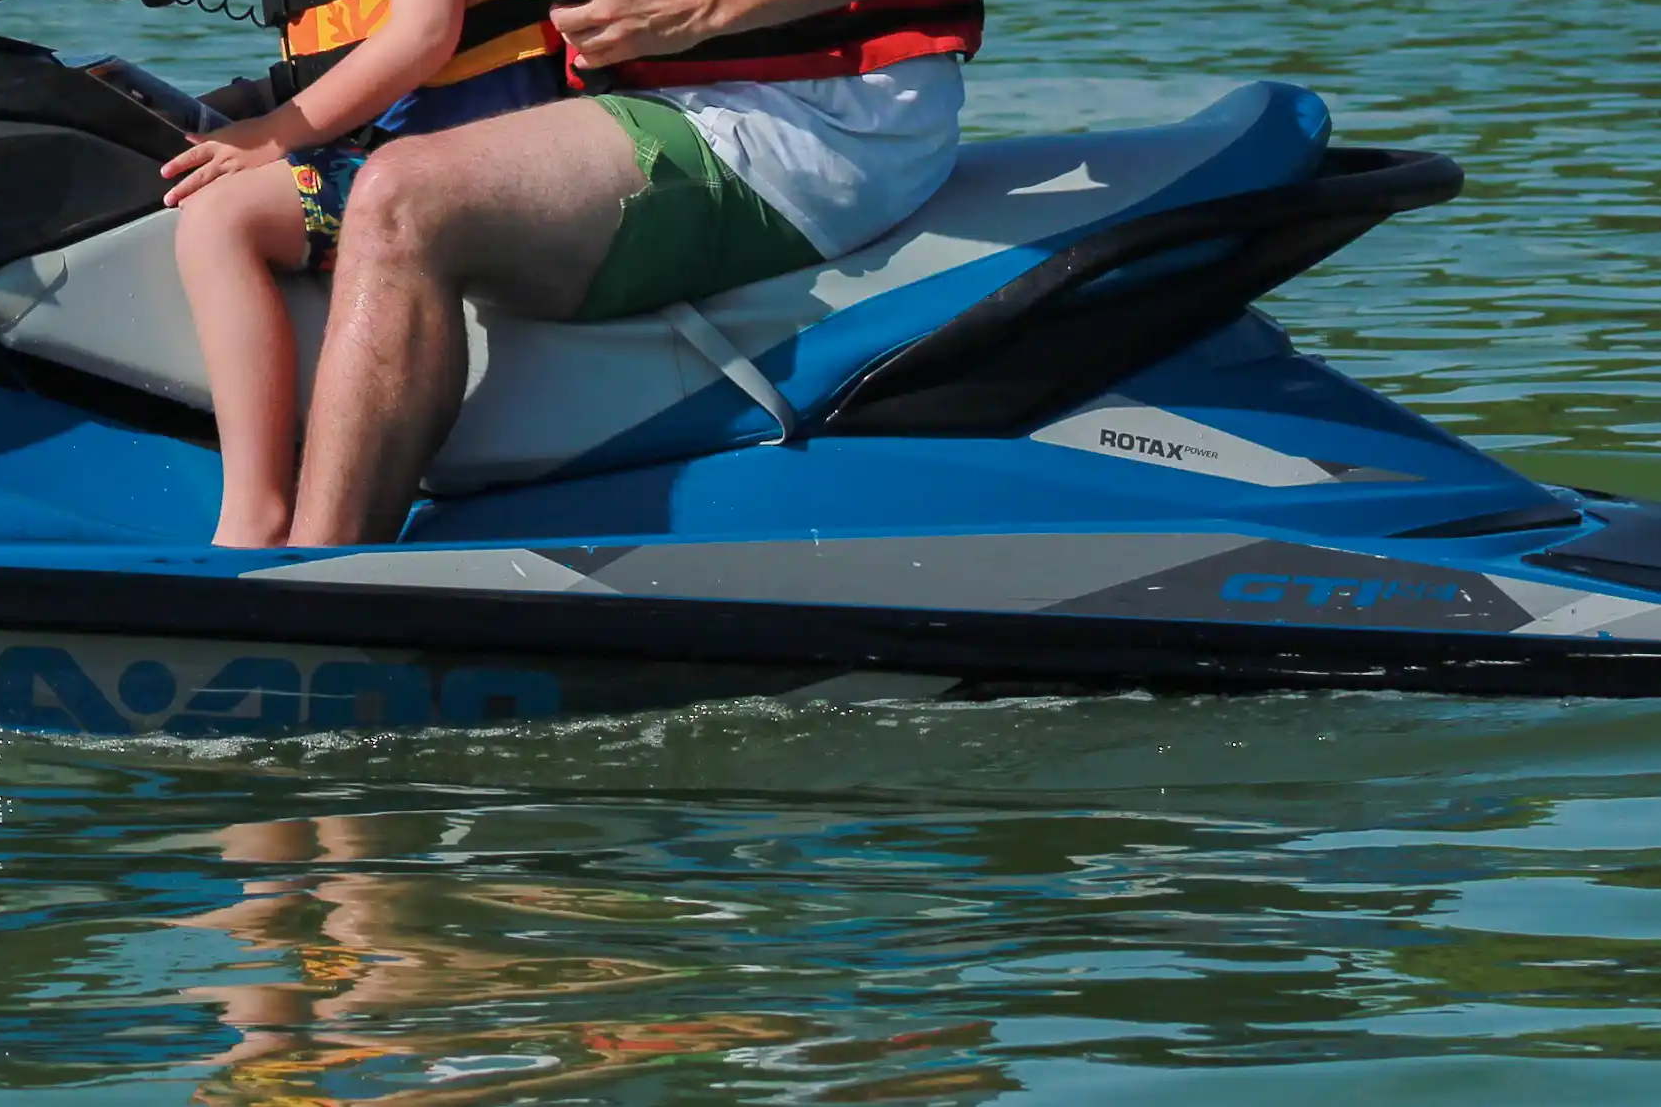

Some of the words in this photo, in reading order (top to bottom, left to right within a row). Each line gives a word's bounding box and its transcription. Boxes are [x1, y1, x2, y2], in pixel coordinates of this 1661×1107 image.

[1099, 428, 1184, 461] ROTAX
[1184, 445, 1220, 459] POWER
[1219, 573, 1384, 608] GTI
